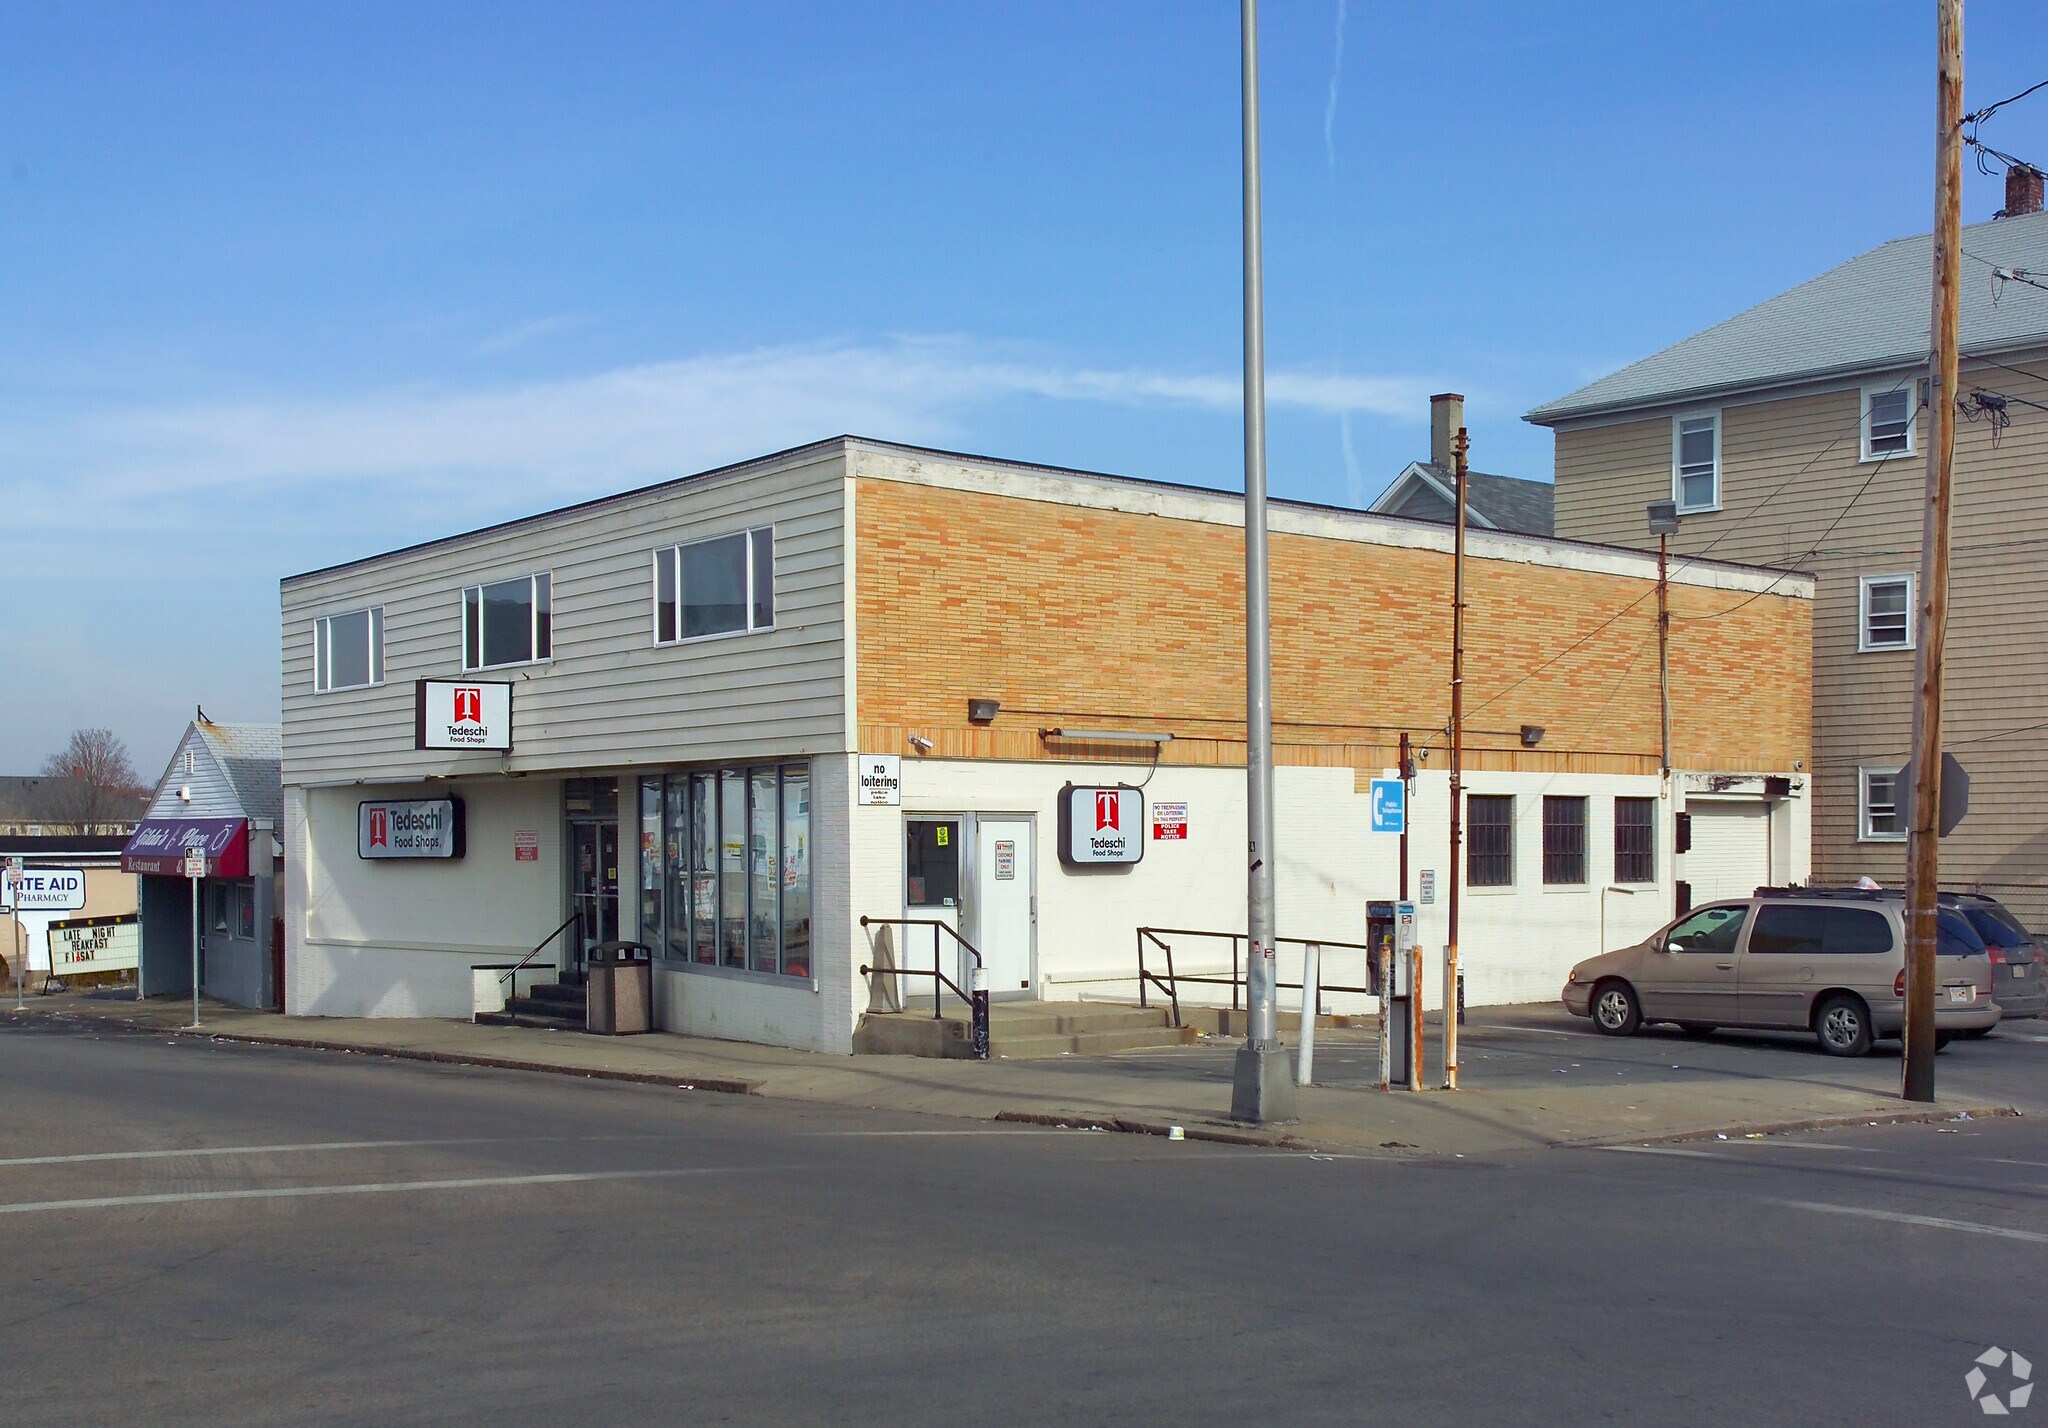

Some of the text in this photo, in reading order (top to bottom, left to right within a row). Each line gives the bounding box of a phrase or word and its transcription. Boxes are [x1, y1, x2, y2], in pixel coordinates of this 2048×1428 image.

[447, 726, 488, 736] Tedeschi
[467, 736, 485, 744] Shops
[874, 765, 885, 774] no
[861, 775, 898, 790] loitering
[390, 807, 442, 831] Tedeschi
[131, 827, 210, 850] Gilda's Place
[394, 835, 439, 850] Food Shops
[1090, 837, 1126, 849] Tedeschi
[128, 856, 160, 872] Restaurant
[49, 877, 78, 891] AID
[63, 926, 115, 941] LATE NIGHT
[71, 938, 108, 951] REAKFAST
